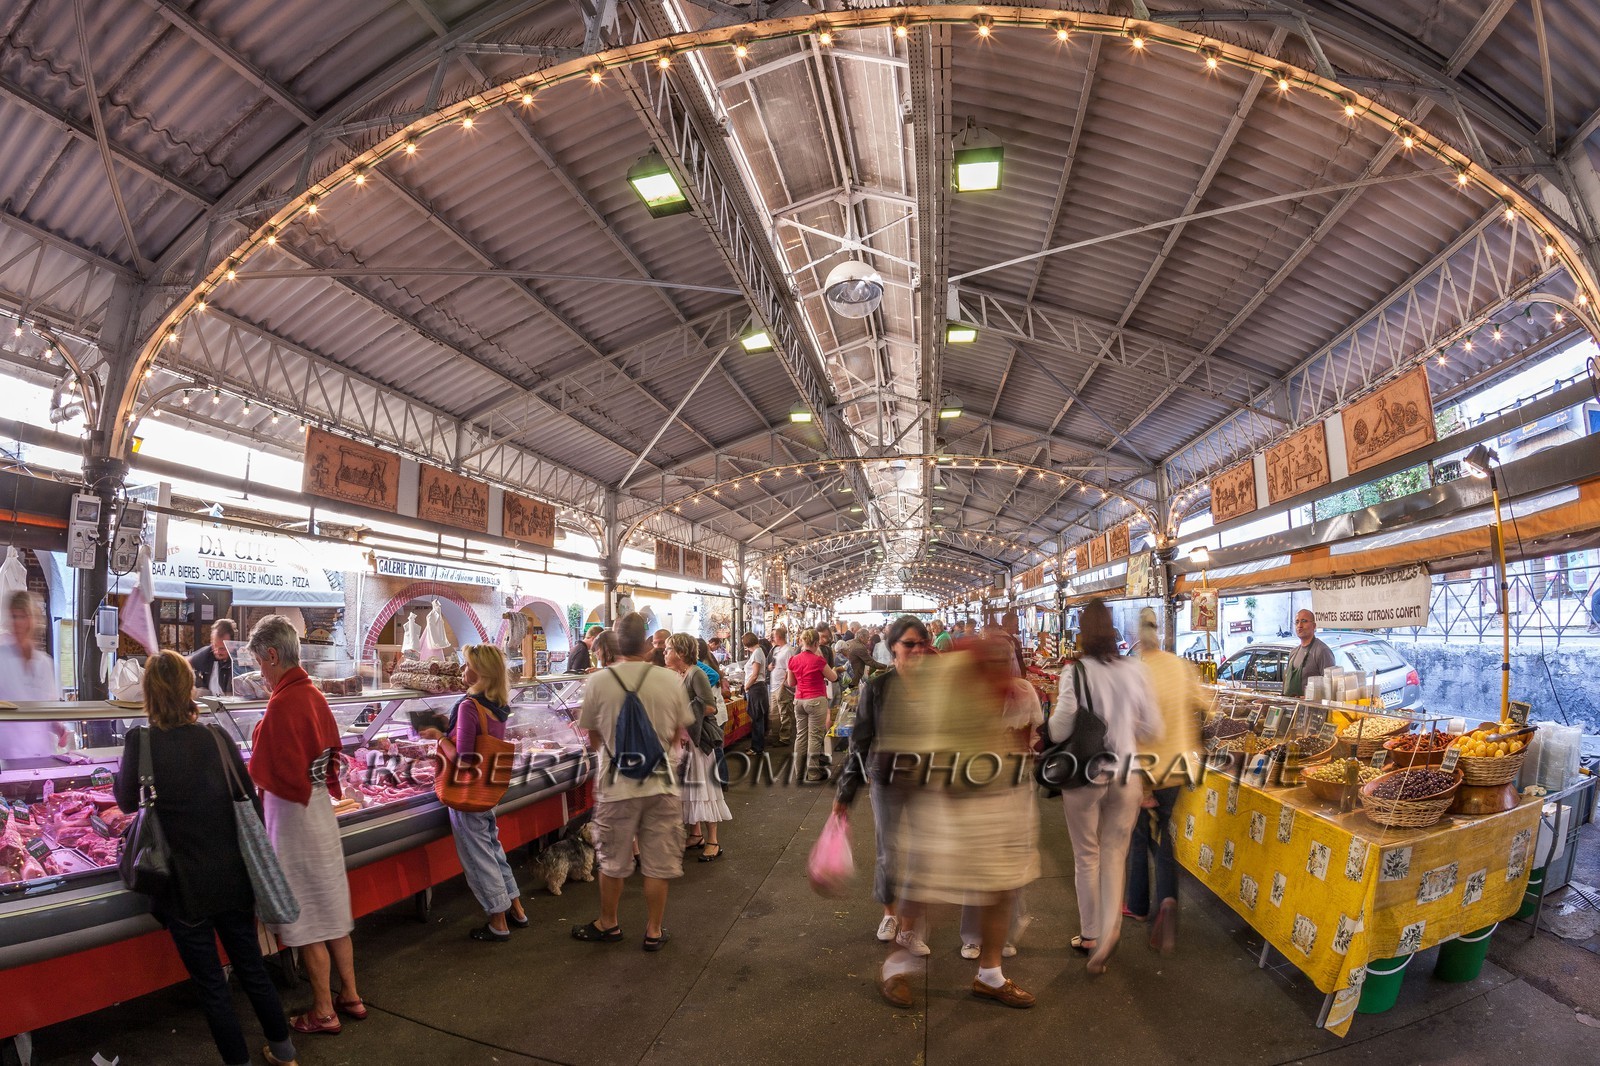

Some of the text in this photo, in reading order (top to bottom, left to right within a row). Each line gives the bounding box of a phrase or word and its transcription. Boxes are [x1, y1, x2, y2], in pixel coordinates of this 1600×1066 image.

[198, 534, 226, 557] DA
[152, 562, 167, 576] BAR
[178, 565, 200, 579] BIERES
[207, 569, 246, 584] SPECIALITES
[247, 572, 256, 584] DE
[258, 573, 284, 586] MOULES
[292, 577, 310, 588] PIZZA
[378, 559, 407, 575] GALERIE
[408, 562, 427, 578] D'ART
[1314, 576, 1356, 591] SPECIALITES
[1314, 611, 1338, 622] TOMATES
[1366, 608, 1394, 621] CITRONS
